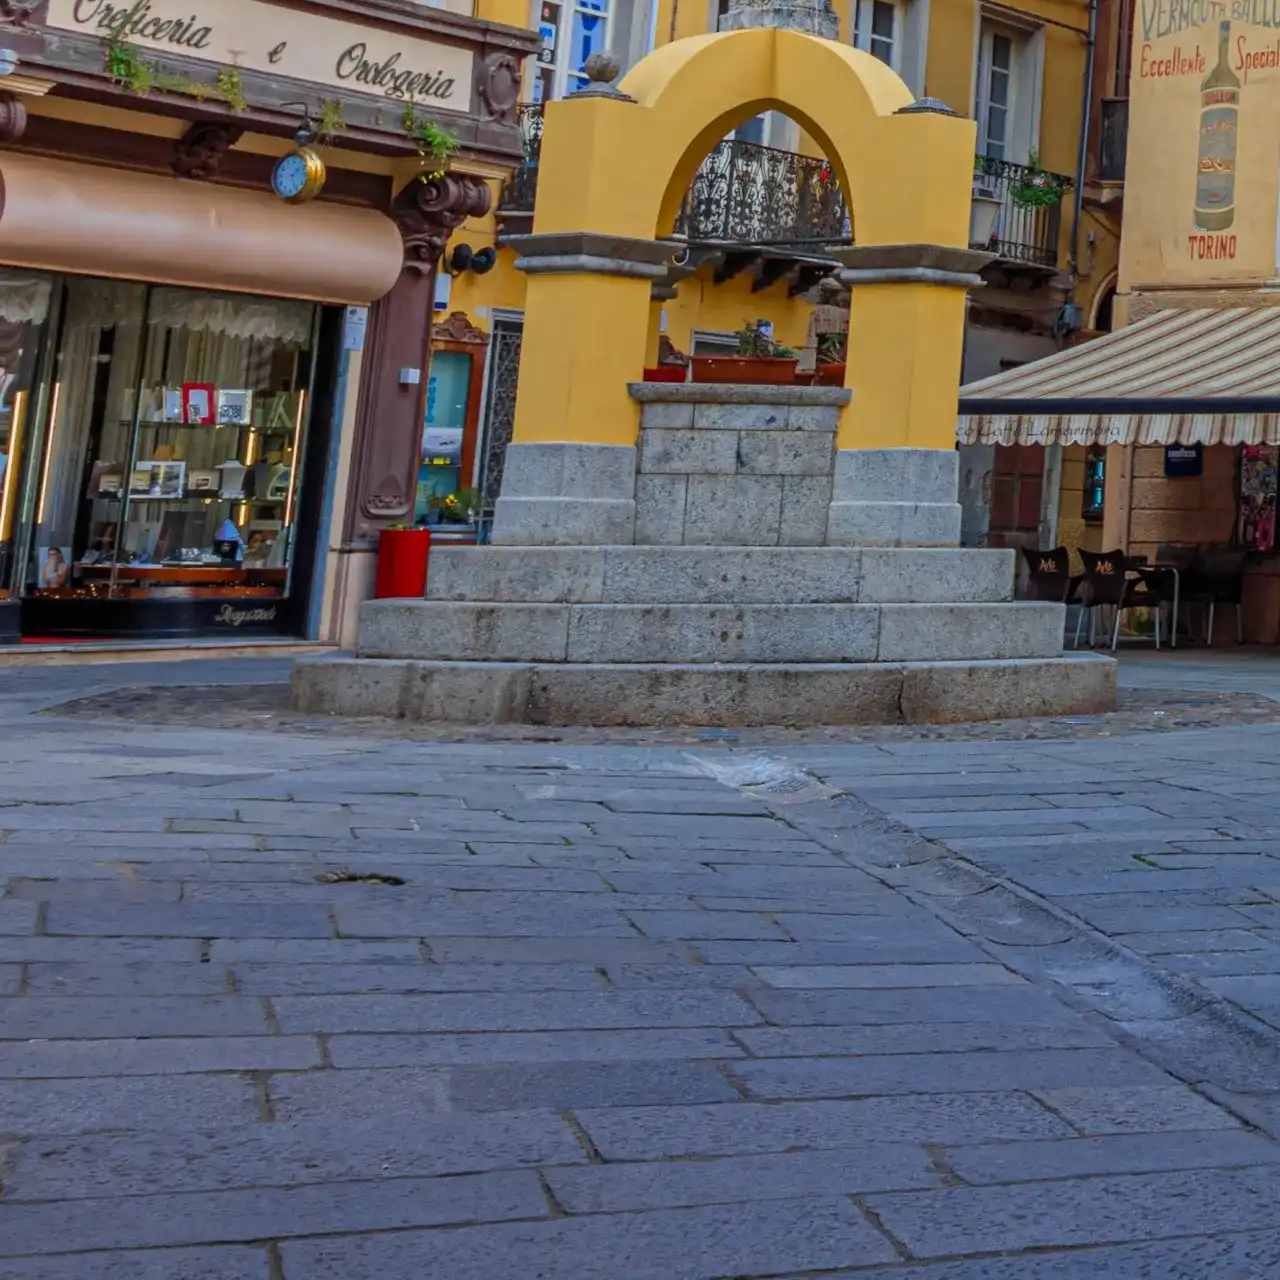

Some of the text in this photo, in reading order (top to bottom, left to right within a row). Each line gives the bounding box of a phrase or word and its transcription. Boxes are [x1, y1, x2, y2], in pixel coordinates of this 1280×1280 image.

[268, 41, 287, 64] e
[336, 42, 456, 99] Orologeria
[1140, 44, 1205, 78] Eccellente
[1188, 235, 1236, 260] TORINO
[1027, 419, 1121, 437] Lamarmora
